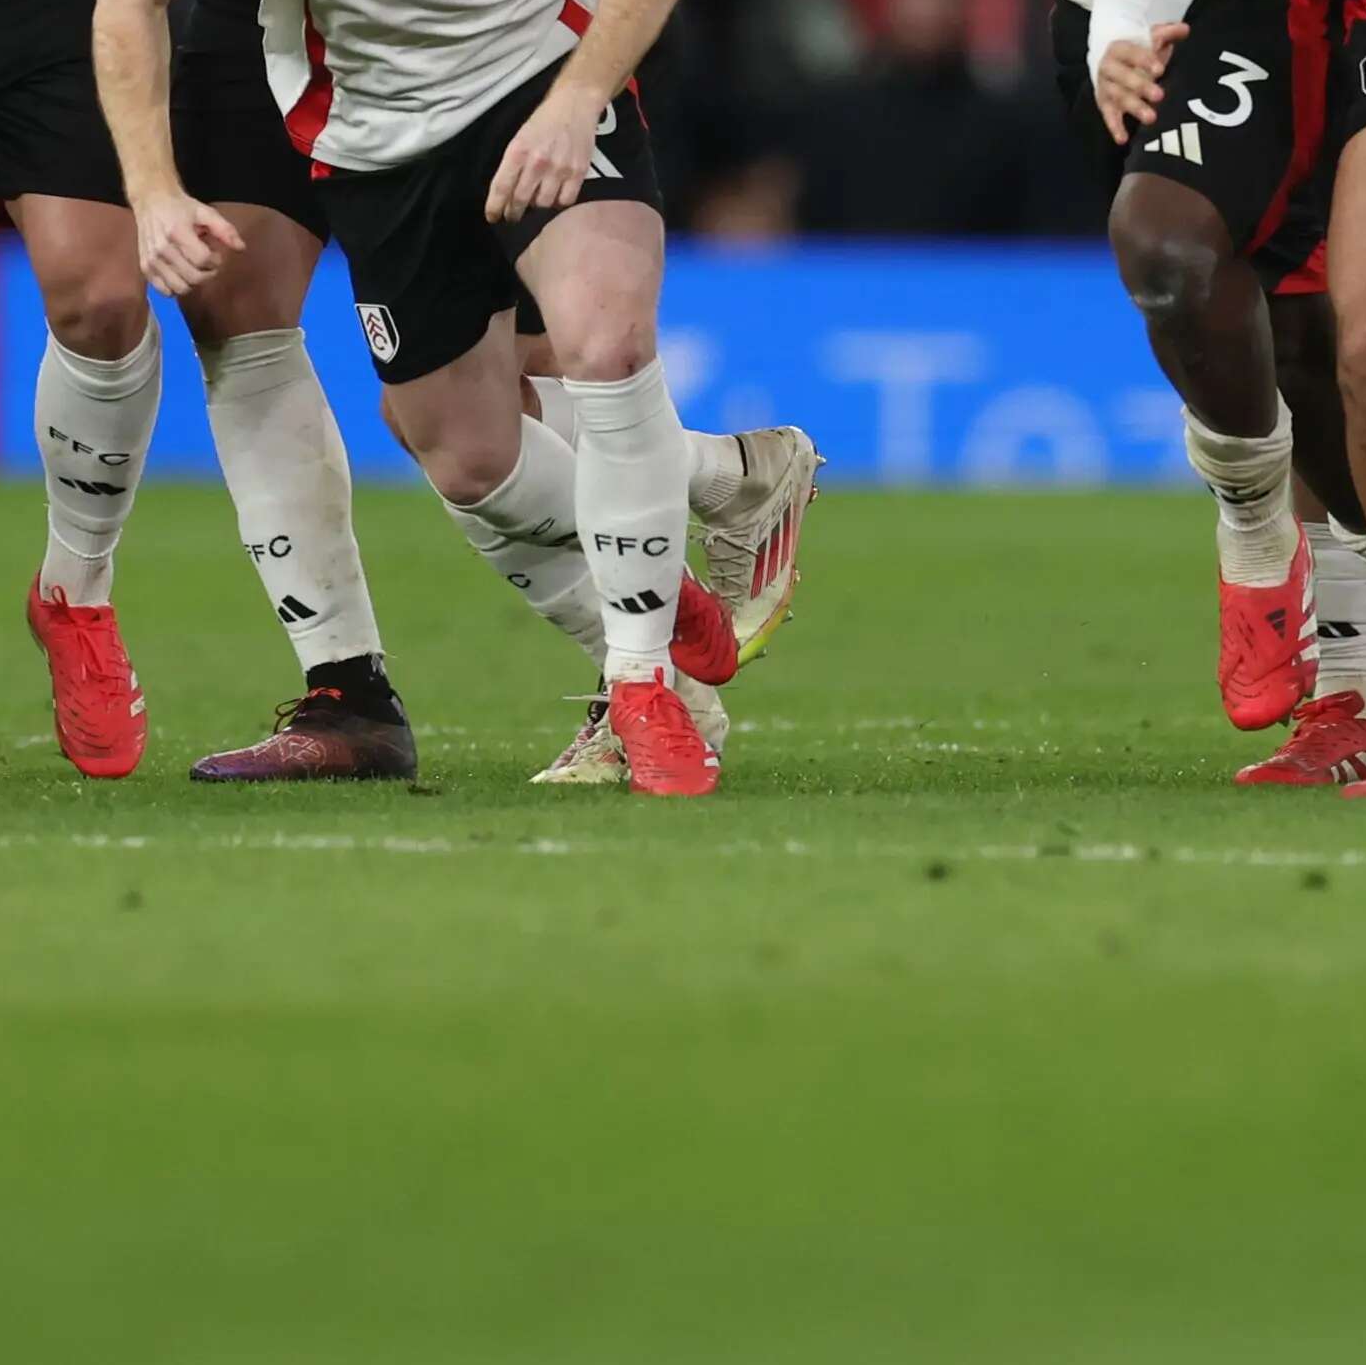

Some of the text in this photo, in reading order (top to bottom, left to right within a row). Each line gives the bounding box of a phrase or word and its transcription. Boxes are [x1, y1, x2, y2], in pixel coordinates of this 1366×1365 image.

[1187, 50, 1270, 127] 3
[49, 426, 131, 466] FFC
[595, 534, 669, 557] FFC
